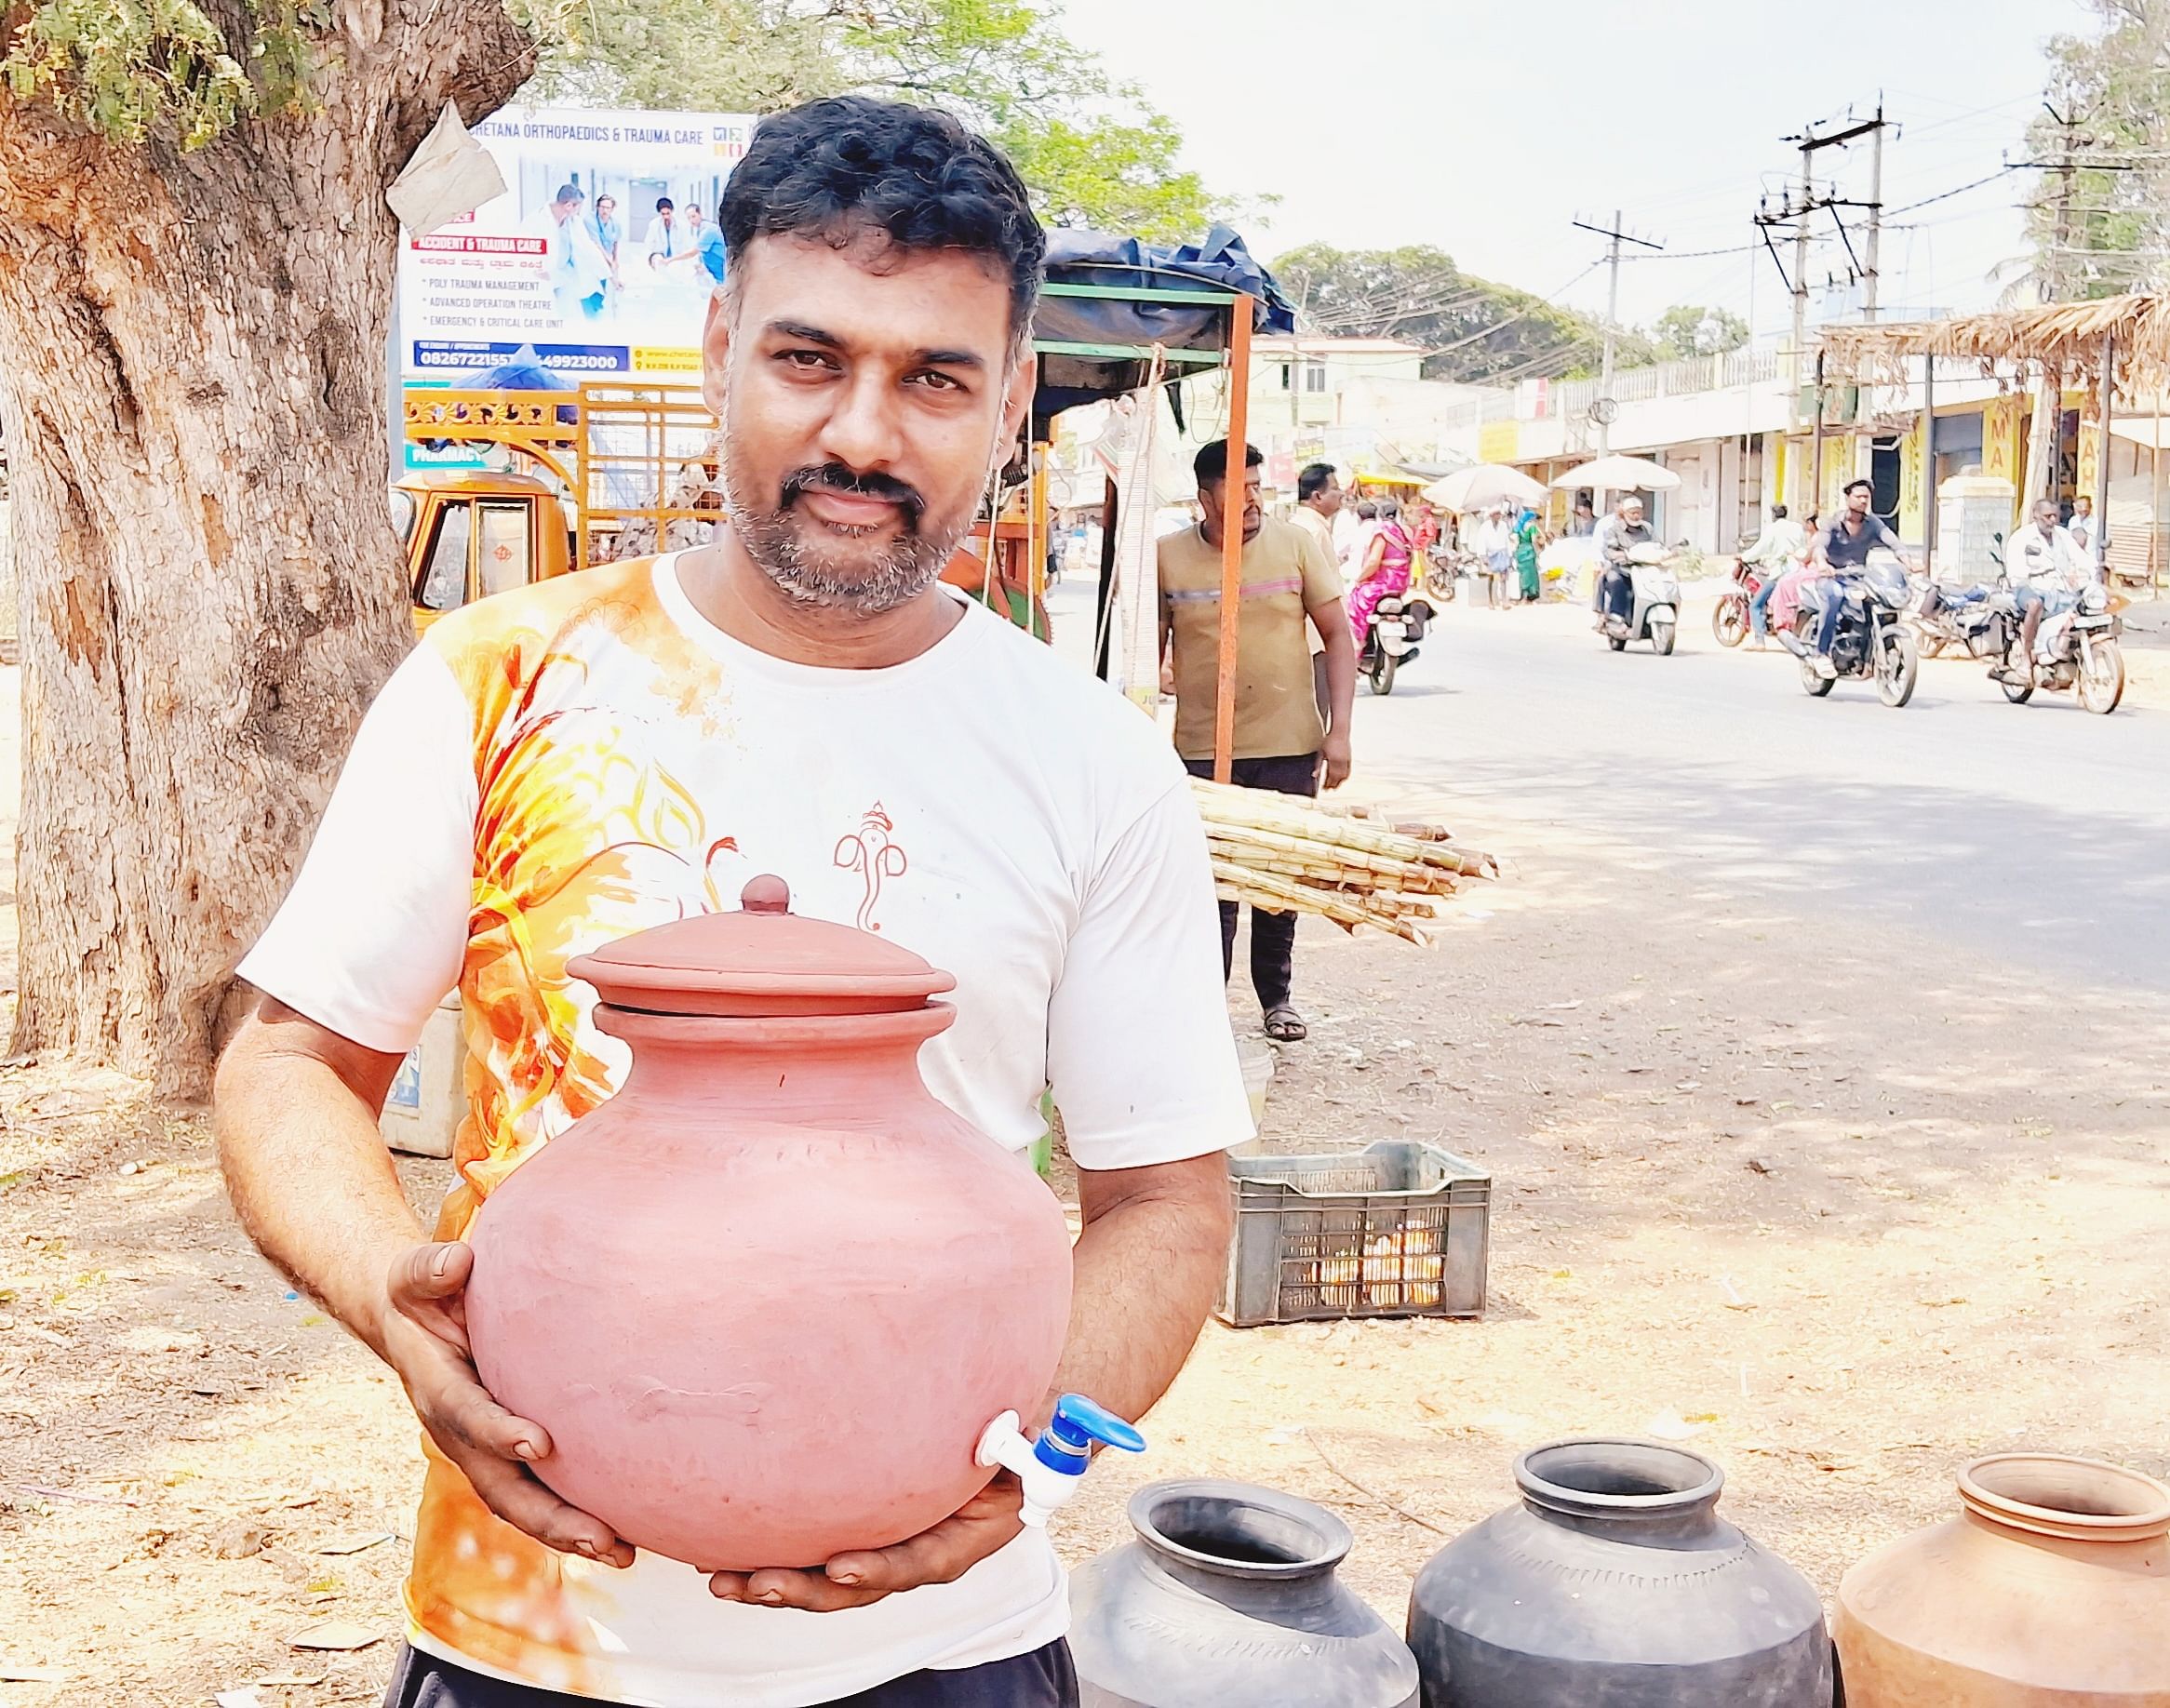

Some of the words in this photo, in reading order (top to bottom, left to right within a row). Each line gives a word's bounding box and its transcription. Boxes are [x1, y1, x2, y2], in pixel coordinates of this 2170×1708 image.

[524, 124, 609, 140] ORTHOPAEDICS
[612, 128, 620, 141] &
[624, 128, 671, 143] TRAUMA
[675, 130, 703, 144] CARE
[418, 236, 465, 249] ACCIDENT
[466, 238, 475, 250] &
[476, 238, 515, 252] TRAUMA
[516, 239, 542, 253] CARE
[429, 278, 448, 288] POLY
[451, 279, 482, 289] TRAUMA
[486, 280, 540, 291] MANAGEMENT
[430, 297, 471, 308] ADVANCED
[473, 299, 516, 309] OPERATION
[518, 300, 552, 311] THEATRE
[430, 315, 476, 327] EMERGENCY
[479, 317, 485, 327] &
[487, 317, 520, 328] CRITICAL
[524, 318, 543, 328] CARE
[546, 319, 564, 328] UNIT
